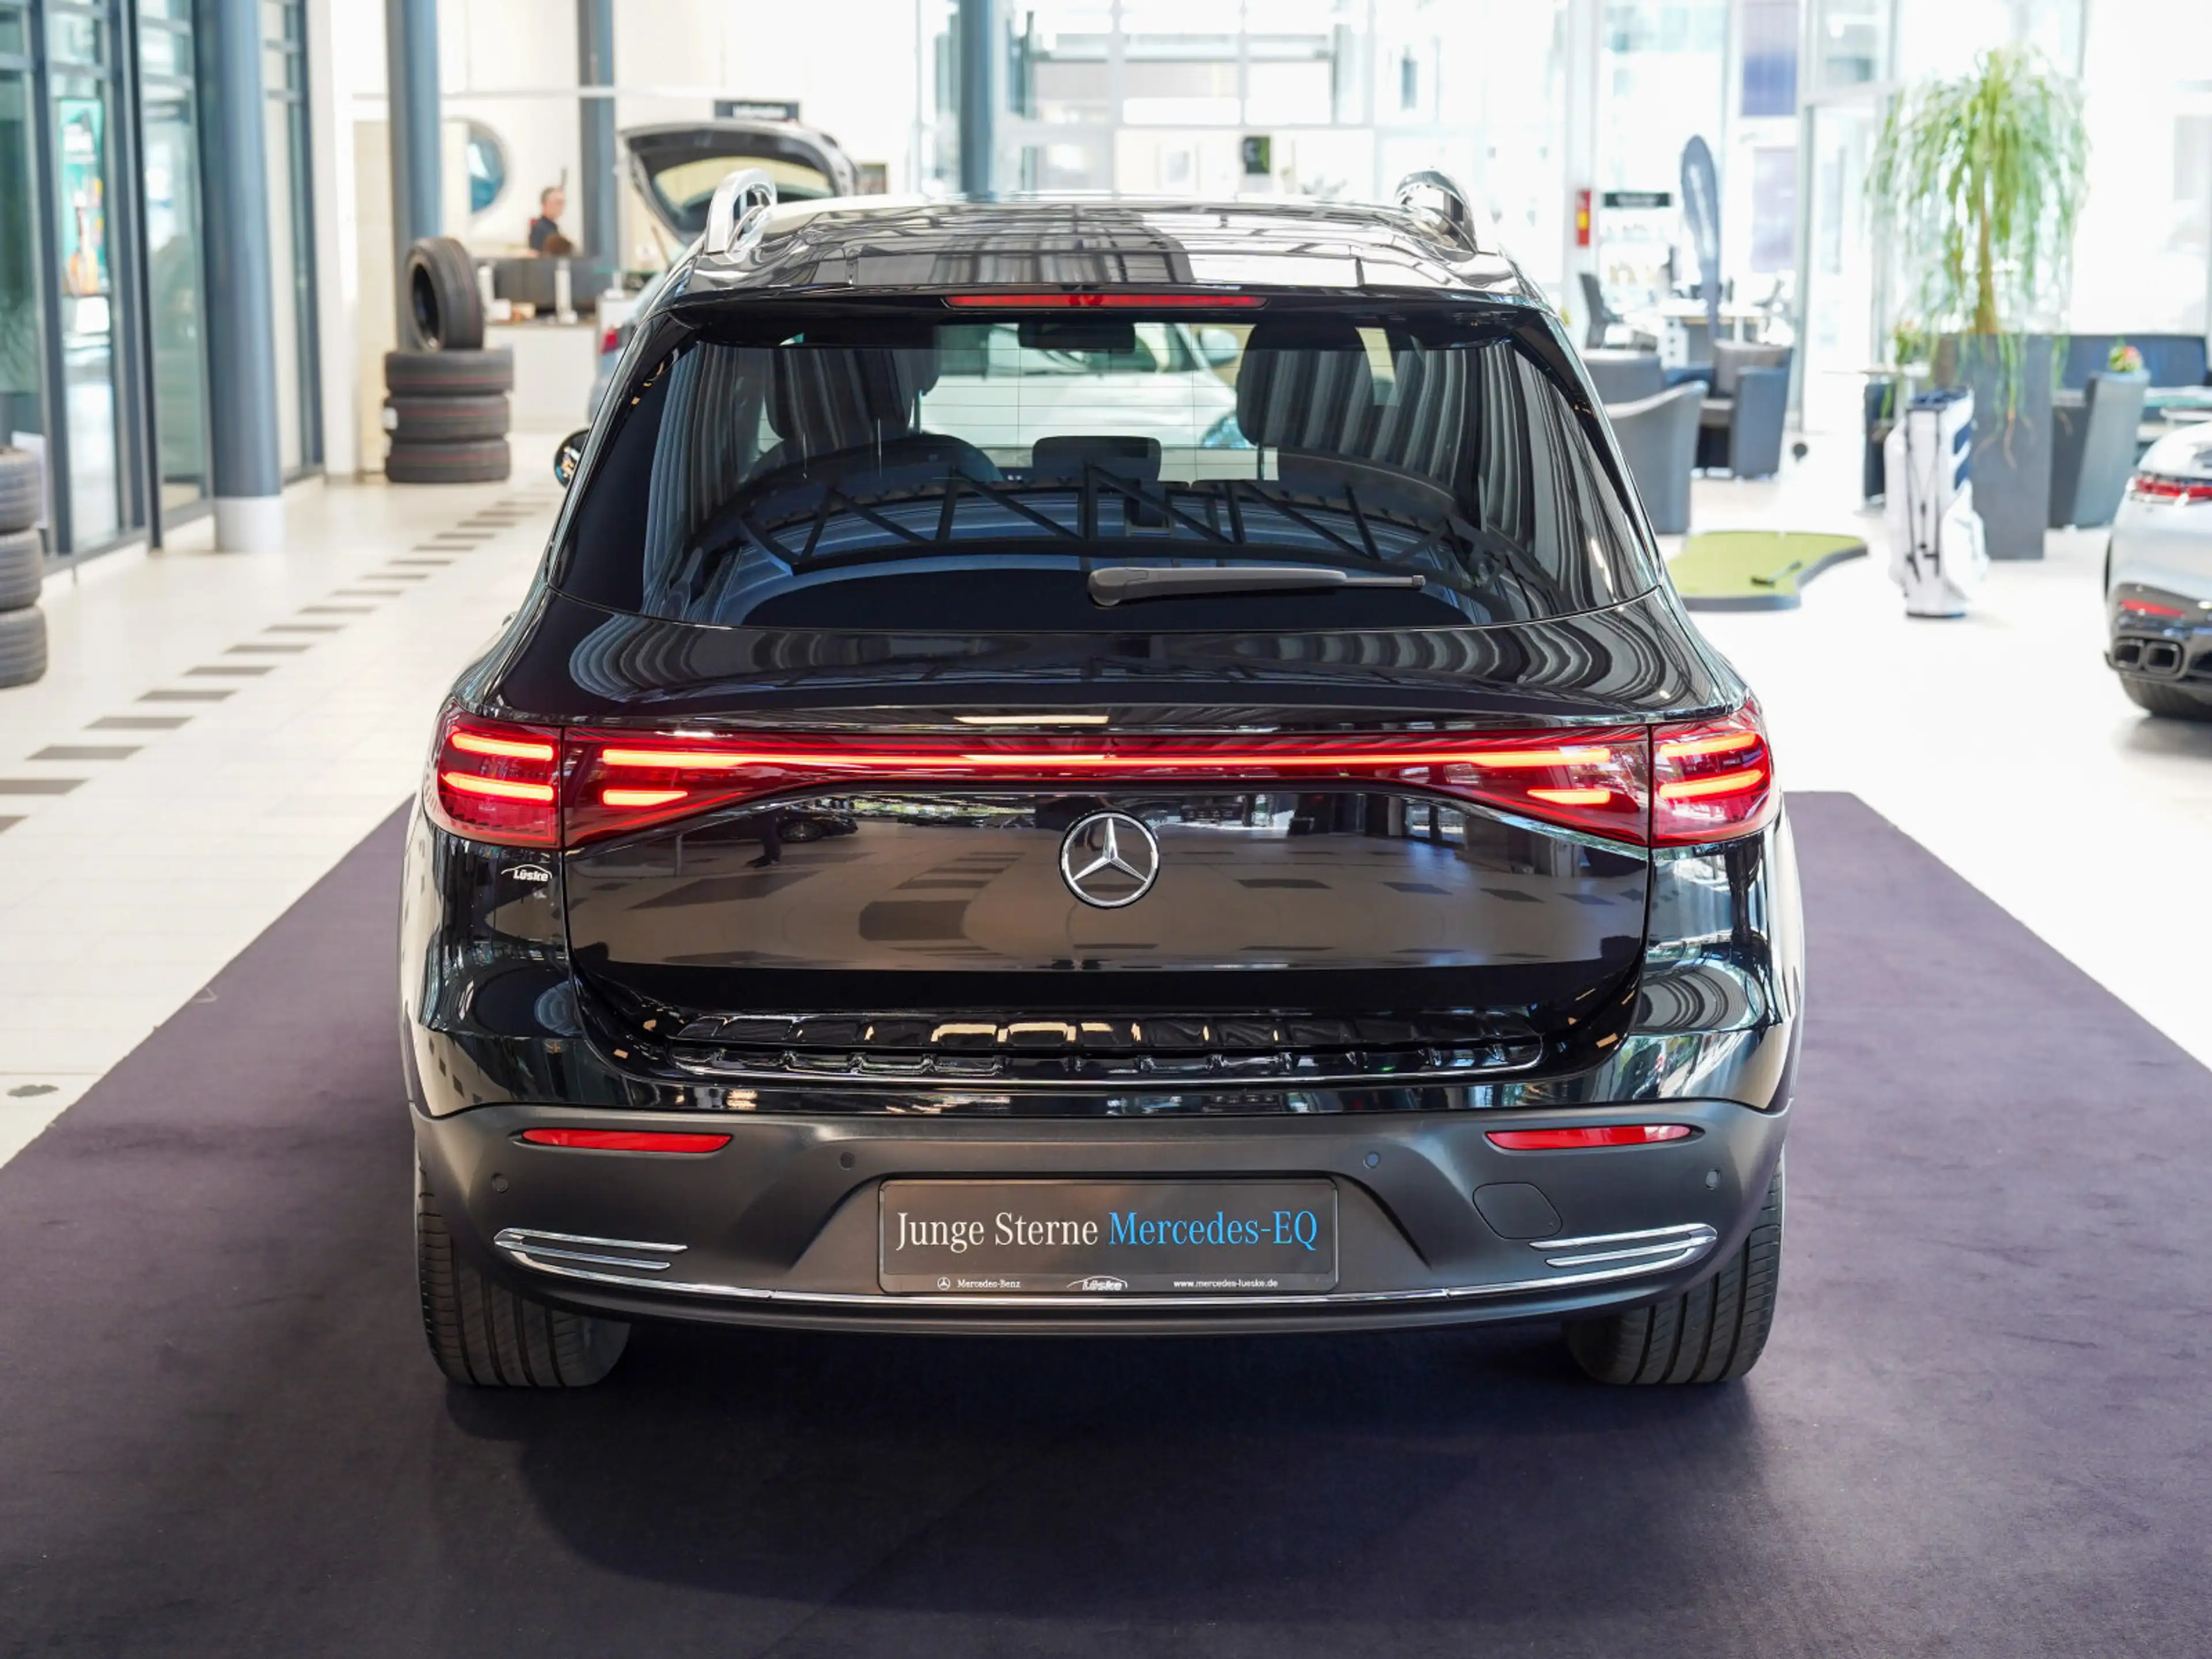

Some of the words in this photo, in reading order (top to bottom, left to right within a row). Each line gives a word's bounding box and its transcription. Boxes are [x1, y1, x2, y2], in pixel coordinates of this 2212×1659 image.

[896, 1212, 984, 1253] Junge
[995, 1212, 1098, 1245] Sterne
[1108, 1211, 1317, 1251] Mercedes-EQ
[957, 1279, 1021, 1289] Mercedes-Benz
[1173, 1279, 1278, 1288] www.mercedes-lueske.de
